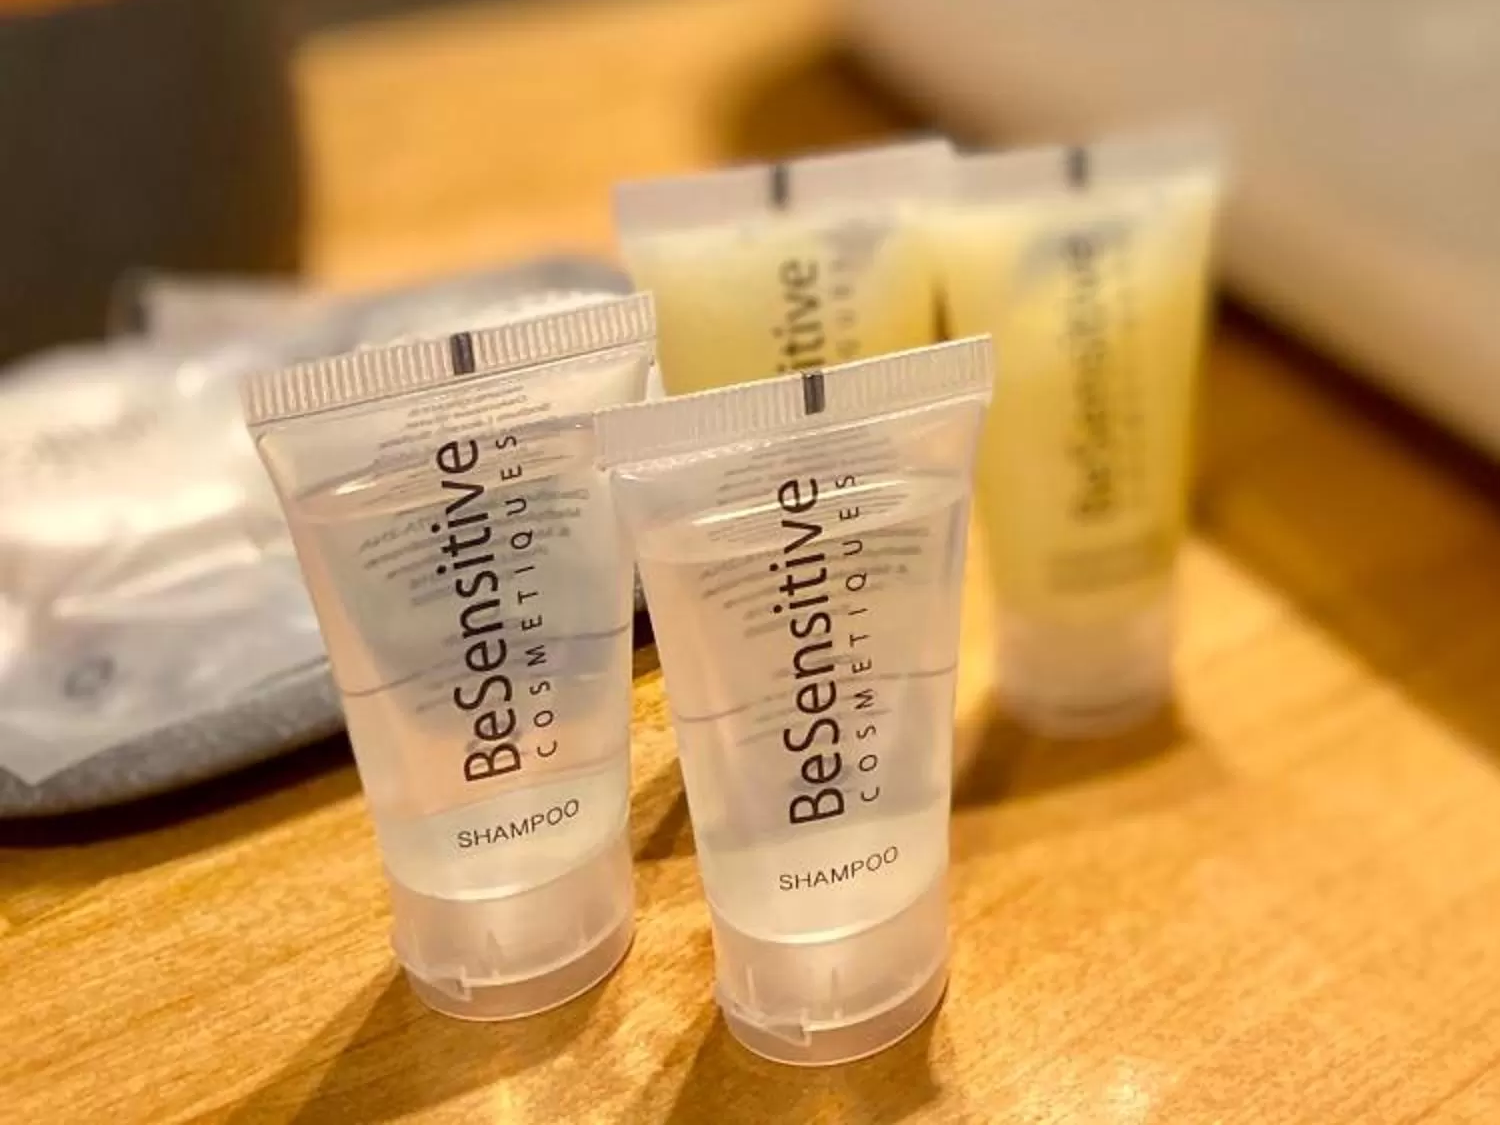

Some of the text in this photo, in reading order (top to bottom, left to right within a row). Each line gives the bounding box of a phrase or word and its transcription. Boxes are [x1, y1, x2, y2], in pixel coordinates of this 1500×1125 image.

[431, 439, 521, 784] BeSensitive
[495, 434, 558, 759] COSMETIQUES
[769, 477, 846, 825] BeSensitive
[833, 474, 881, 804] COSMETIQUES
[457, 797, 581, 848] SHAMPOO
[779, 845, 899, 891] SHAMPOO
